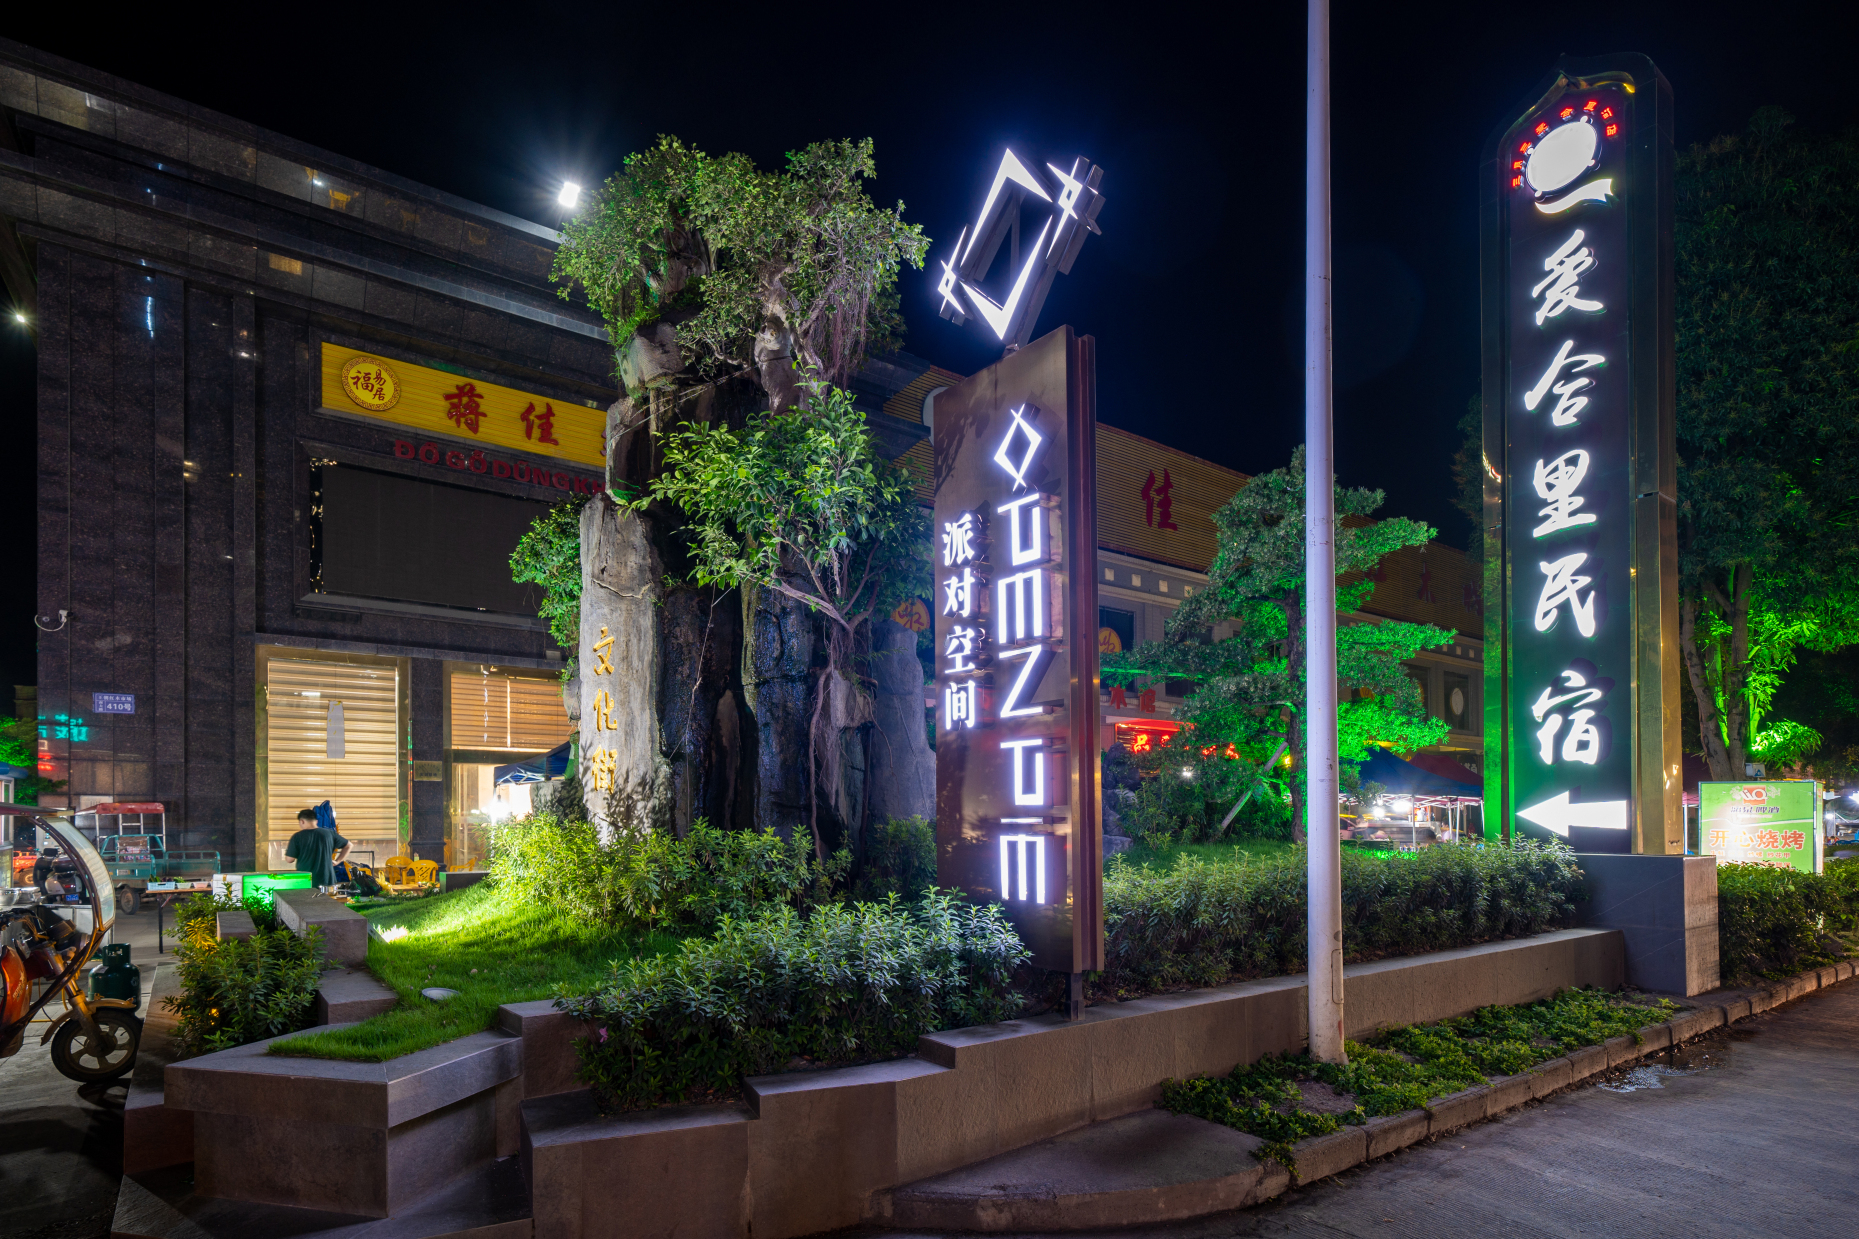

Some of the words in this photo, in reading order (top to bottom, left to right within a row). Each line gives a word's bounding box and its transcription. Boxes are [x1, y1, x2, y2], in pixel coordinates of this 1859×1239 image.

[492, 459, 570, 491] DŨNG
[942, 513, 976, 731] 派对空间
[106, 703, 132, 711] 410号
[591, 626, 618, 795] 文化街
[1709, 828, 1805, 850] 开心烧烤
